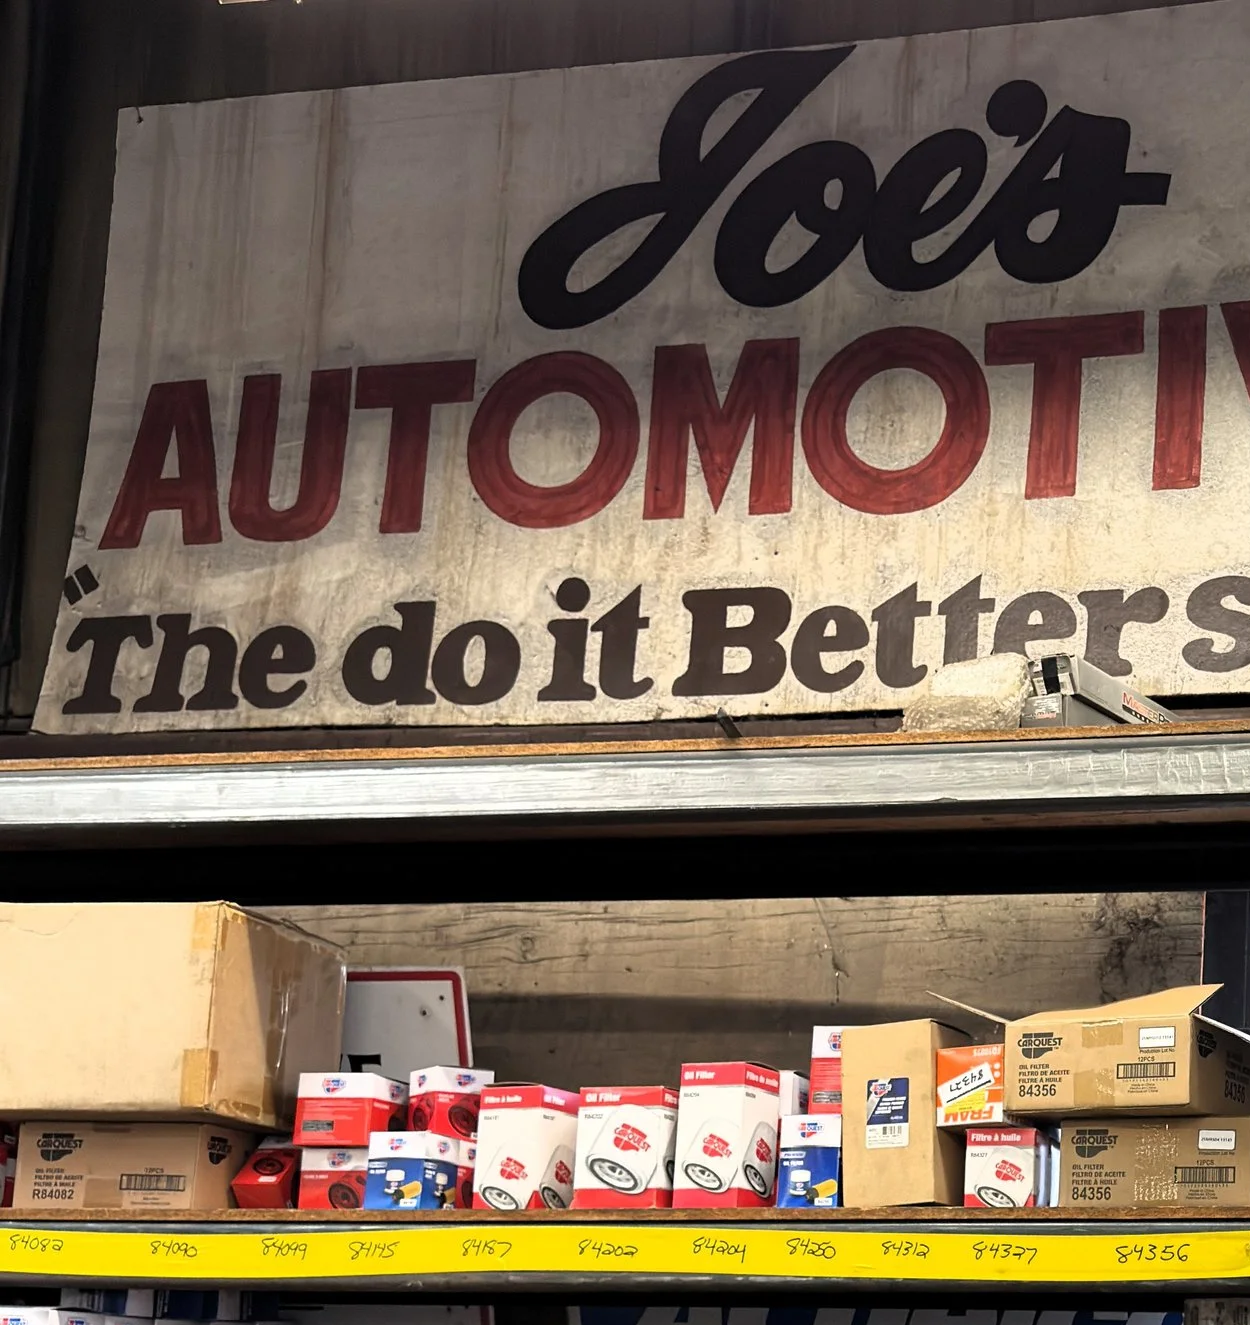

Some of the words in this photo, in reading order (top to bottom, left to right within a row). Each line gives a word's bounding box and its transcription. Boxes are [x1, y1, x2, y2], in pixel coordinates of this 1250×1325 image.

[518, 45, 1170, 330] Joe's
[342, 605, 520, 706] do
[545, 575, 655, 702] it
[672, 585, 1165, 698] Better
[1017, 1037, 1063, 1048] CARQUEST
[684, 1070, 694, 1081] Oil
[695, 1069, 715, 1080] Filter
[1018, 1084, 1056, 1097] 84356
[585, 1092, 597, 1103] Oil
[598, 1092, 621, 1103] Filter
[943, 1105, 994, 1123] FRAM
[613, 1125, 652, 1153] CARQUEST
[971, 1133, 992, 1142] Filtre
[1000, 1133, 1021, 1142] huile
[1071, 1135, 1118, 1146] CARQUEST
[36, 1140, 83, 1149] CARQUEST
[32, 1188, 74, 1200] R84082
[1072, 1187, 1112, 1200] 84356
[150, 1239, 198, 1258] 84090
[692, 1237, 747, 1264] 84204
[881, 1241, 930, 1259] 84312
[1116, 1244, 1191, 1264] 84356
